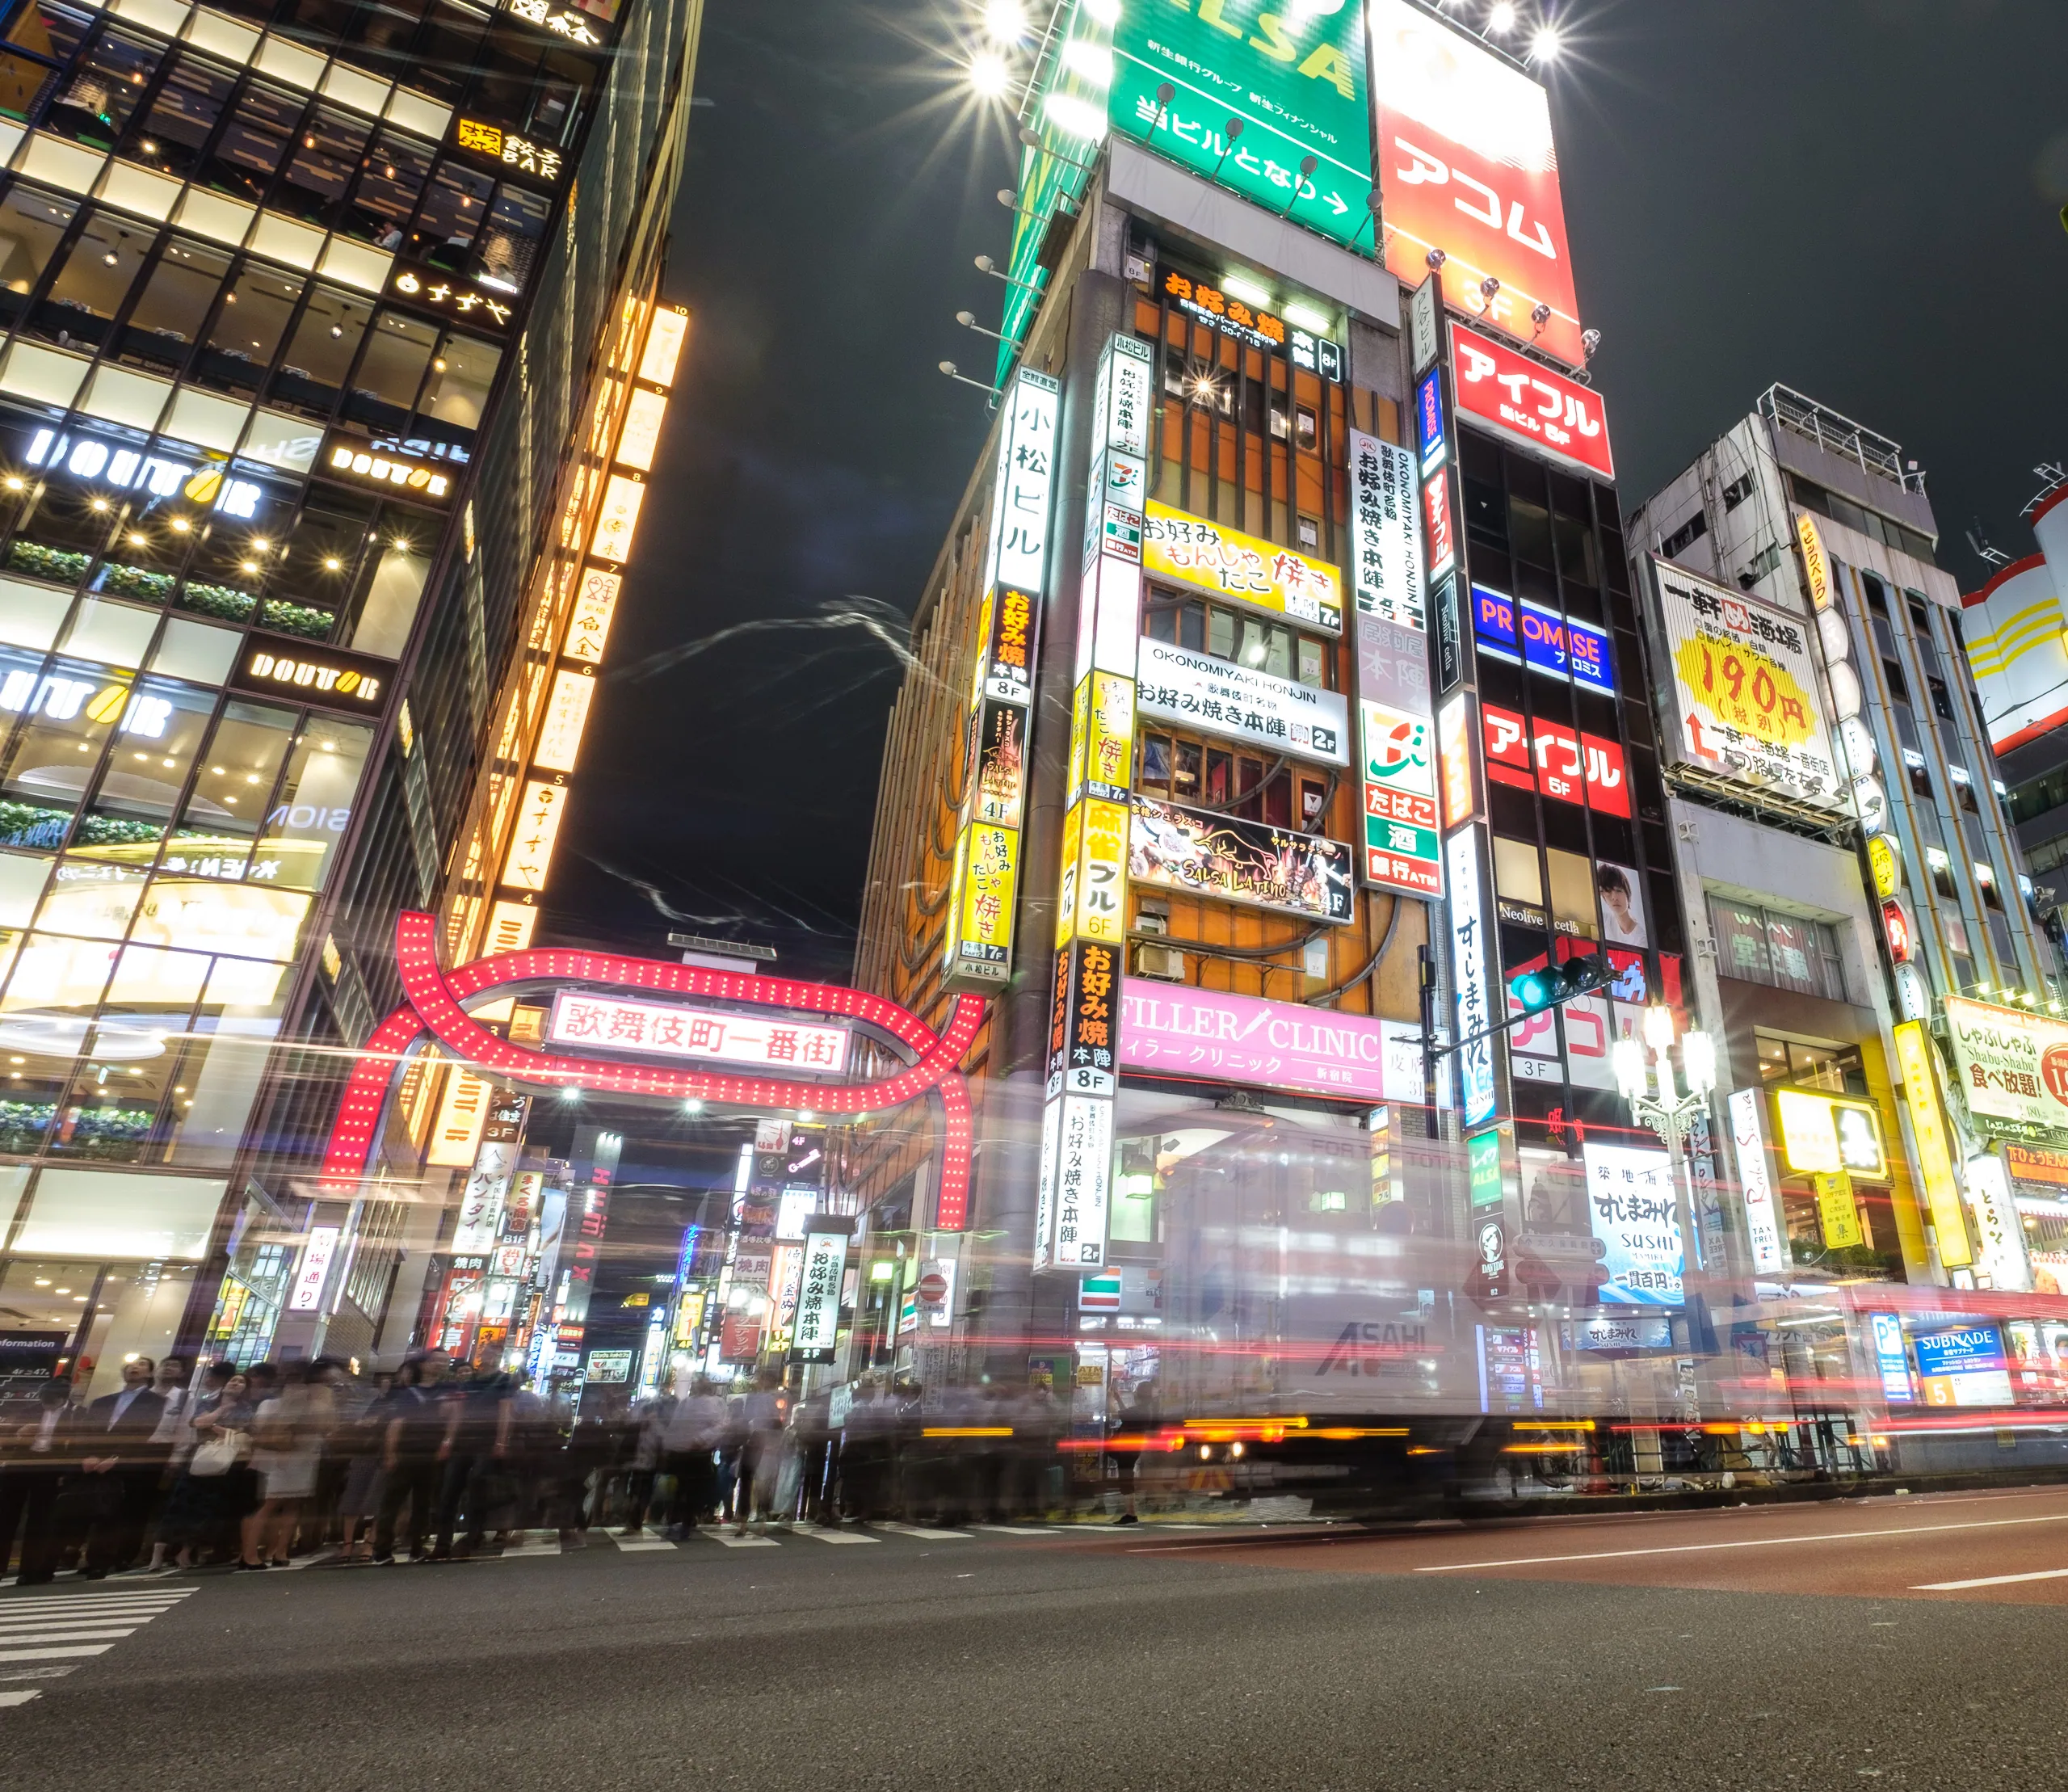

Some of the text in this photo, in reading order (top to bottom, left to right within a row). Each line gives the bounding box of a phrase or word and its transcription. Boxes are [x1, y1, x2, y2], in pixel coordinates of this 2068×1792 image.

[1147, 39, 1338, 145] 新生銀行グループ 新生フィナンシャル
[1136, 95, 1316, 200] 当ビルとなり
[502, 149, 557, 181] BAR
[1395, 137, 1556, 259] アコム
[428, 284, 511, 325] すずや
[675, 305, 687, 315] 10
[1166, 272, 1284, 343] お好み焼
[1116, 336, 1149, 358] 小松ビル
[1322, 353, 1337, 368] 8F
[1460, 343, 1600, 437] アイフル
[1424, 380, 1437, 440] PROMISE
[331, 448, 448, 497] DOUTOR
[633, 473, 641, 482] 8
[1007, 407, 1050, 555] 小松ビル
[1108, 506, 1141, 527] たばこ
[1359, 451, 1384, 589] お好み焼き本陣
[1398, 452, 1418, 604] OKONOMIYAKI HONJIN
[1114, 523, 1131, 542] 酒
[1143, 516, 1220, 545] お好み
[610, 564, 619, 574] 7
[1166, 545, 1260, 567] もんじゃ
[1218, 567, 1271, 592] たこ
[1274, 554, 1331, 596] 焼き
[998, 591, 1031, 667] お好み焼
[1441, 604, 1451, 645] Neolive
[1482, 599, 1600, 663] PROMISE
[250, 654, 379, 701] DOUTOR
[583, 666, 591, 675] 6
[994, 663, 1028, 684] 本陣
[1153, 648, 1317, 705] OKONOMIYAKI HONJIN
[1360, 650, 1428, 692] 本陣
[1555, 650, 1603, 679] プロミス
[998, 681, 1020, 698] 8F
[1701, 642, 1806, 729] 190円
[1095, 709, 1109, 734] たこ
[1137, 681, 1287, 737] お好み焼き本陣
[1314, 729, 1336, 753] 2F
[1486, 713, 1620, 788] アイフル
[1099, 737, 1123, 780] 焼き
[554, 775, 564, 785] 5
[1549, 776, 1570, 796] 5F
[985, 802, 1010, 820] 4F
[1369, 789, 1434, 825] たばこ
[518, 806, 548, 886] すずや
[993, 831, 1011, 871] お好み
[1388, 823, 1418, 852] 酒
[980, 834, 1001, 888] もんじゃ
[1087, 806, 1121, 912] 麻雀ブル
[973, 864, 988, 890] たこ
[1182, 860, 1227, 888] SALSA
[522, 894, 532, 904] 4
[1321, 892, 1344, 911] 4F
[975, 894, 1002, 940] 焼き
[1090, 916, 1112, 935] 6F
[1501, 905, 1544, 926] Neolive
[988, 946, 1003, 961] 7F
[965, 963, 999, 976] 小松ビル
[1078, 945, 1112, 1046] お好み焼
[565, 1003, 838, 1066] 歌舞伎町一番街
[1268, 1020, 1379, 1062] CLINIC
[1957, 1021, 2036, 1056] しゃぶしゃぶ
[1074, 1046, 1112, 1068] 本陣
[1188, 1045, 1283, 1075] クリニック
[1525, 1061, 1546, 1077] 3F
[1078, 1070, 1103, 1089] 8F
[1317, 1066, 1353, 1083] 新宿院
[487, 1128, 515, 1138] 3F
[792, 1136, 805, 1146] 4F
[1472, 1147, 1497, 1168] レイク
[1060, 1115, 1084, 1243] お好み焼き本陣
[1473, 1168, 1498, 1187] ALSA
[464, 1173, 493, 1230] バンタイ
[502, 1234, 526, 1245] B1F
[1753, 1226, 1771, 1236] TAX
[1755, 1235, 1773, 1245] FREE
[454, 1257, 483, 1269] 焼肉
[1082, 1245, 1099, 1260] 2F
[801, 1252, 829, 1340] お好み焼本陣
[0, 1339, 55, 1348] formation
[802, 1348, 821, 1358] 2F
[1315, 1322, 1425, 1377] ASAHI
[1923, 1331, 1993, 1349] SUBNADE
[1078, 1365, 1103, 1373] ATM
[1933, 1383, 1948, 1404] 5
